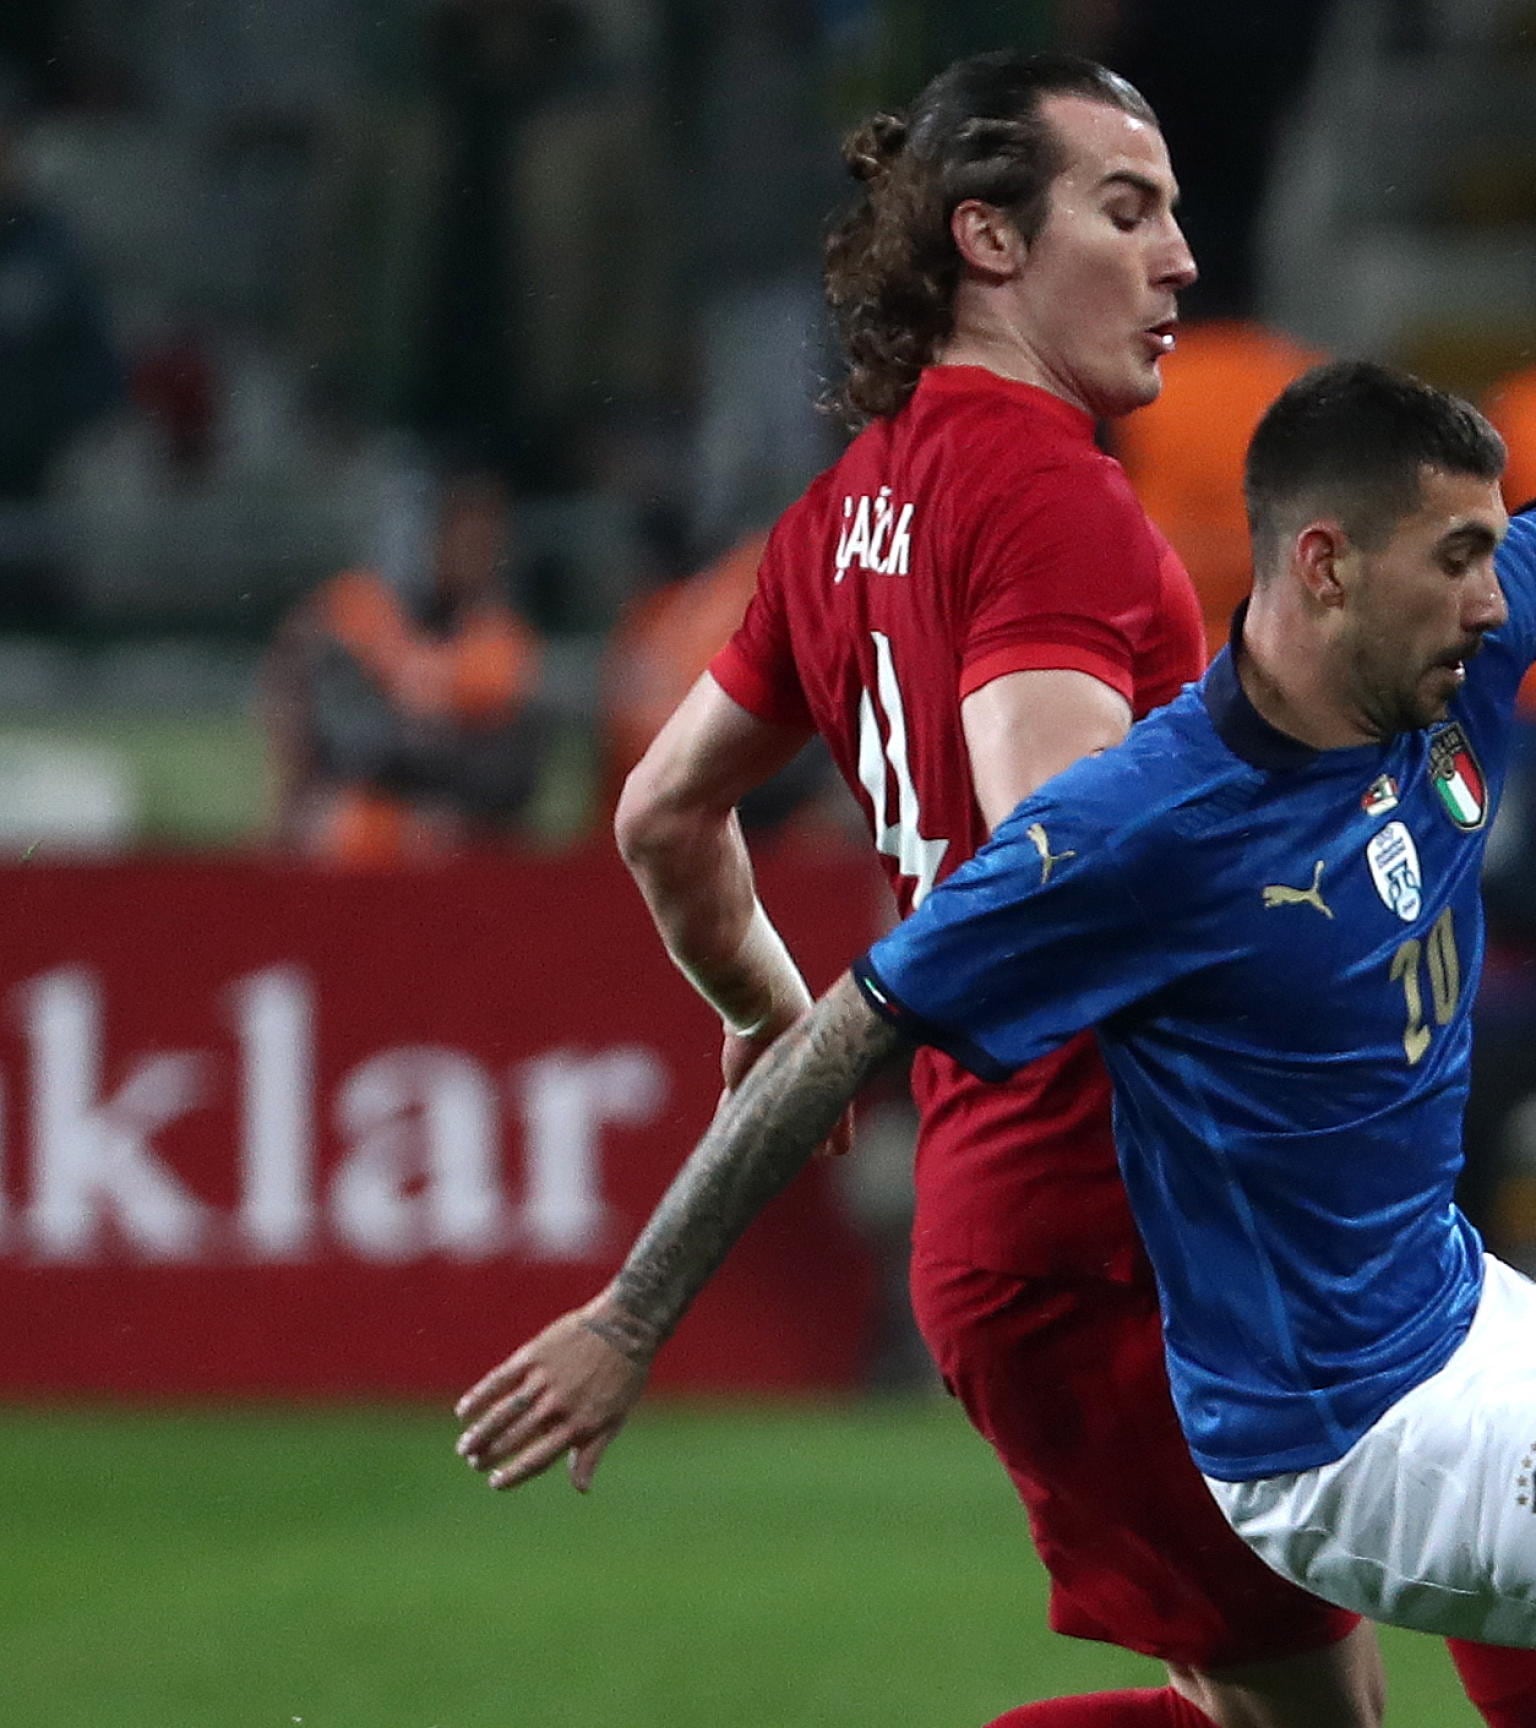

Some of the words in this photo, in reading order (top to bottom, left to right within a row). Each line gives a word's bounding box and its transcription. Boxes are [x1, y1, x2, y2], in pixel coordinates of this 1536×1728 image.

[858, 632, 950, 911] 4
[0, 964, 664, 1260] klar
[1389, 905, 1460, 1065] 20
